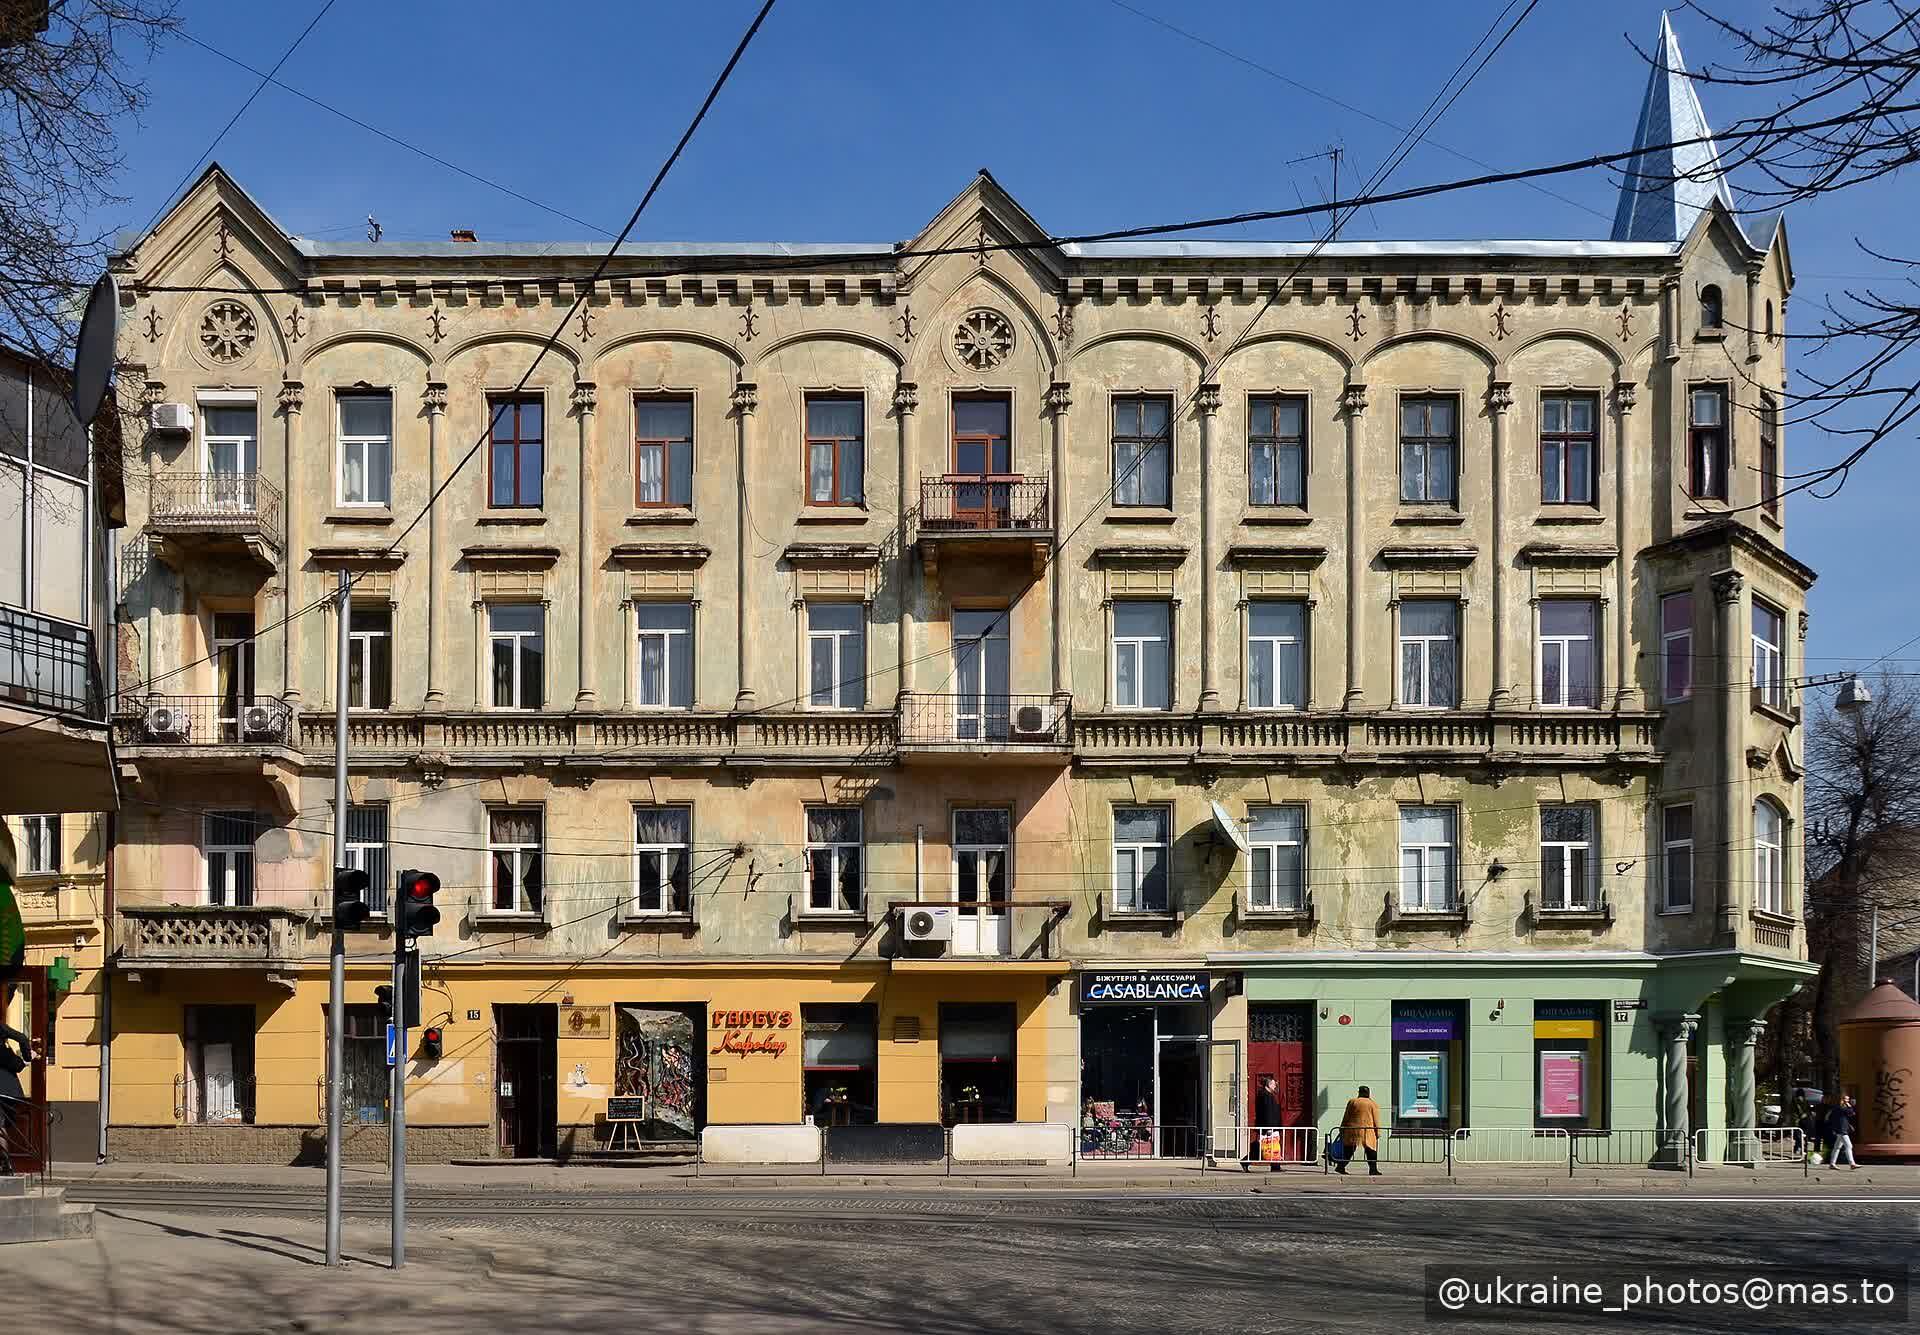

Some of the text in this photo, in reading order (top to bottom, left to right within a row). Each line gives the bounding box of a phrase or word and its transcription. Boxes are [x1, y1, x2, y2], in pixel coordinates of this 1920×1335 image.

[1150, 974, 1196, 982] АКСЕСУАРИ
[1090, 983, 1203, 999] CASABLANCA
[469, 1010, 479, 1019] 15
[712, 1010, 793, 1028] ГАРБУЗ
[1617, 1012, 1627, 1021] 17
[711, 1029, 787, 1059] Кафе-бар
